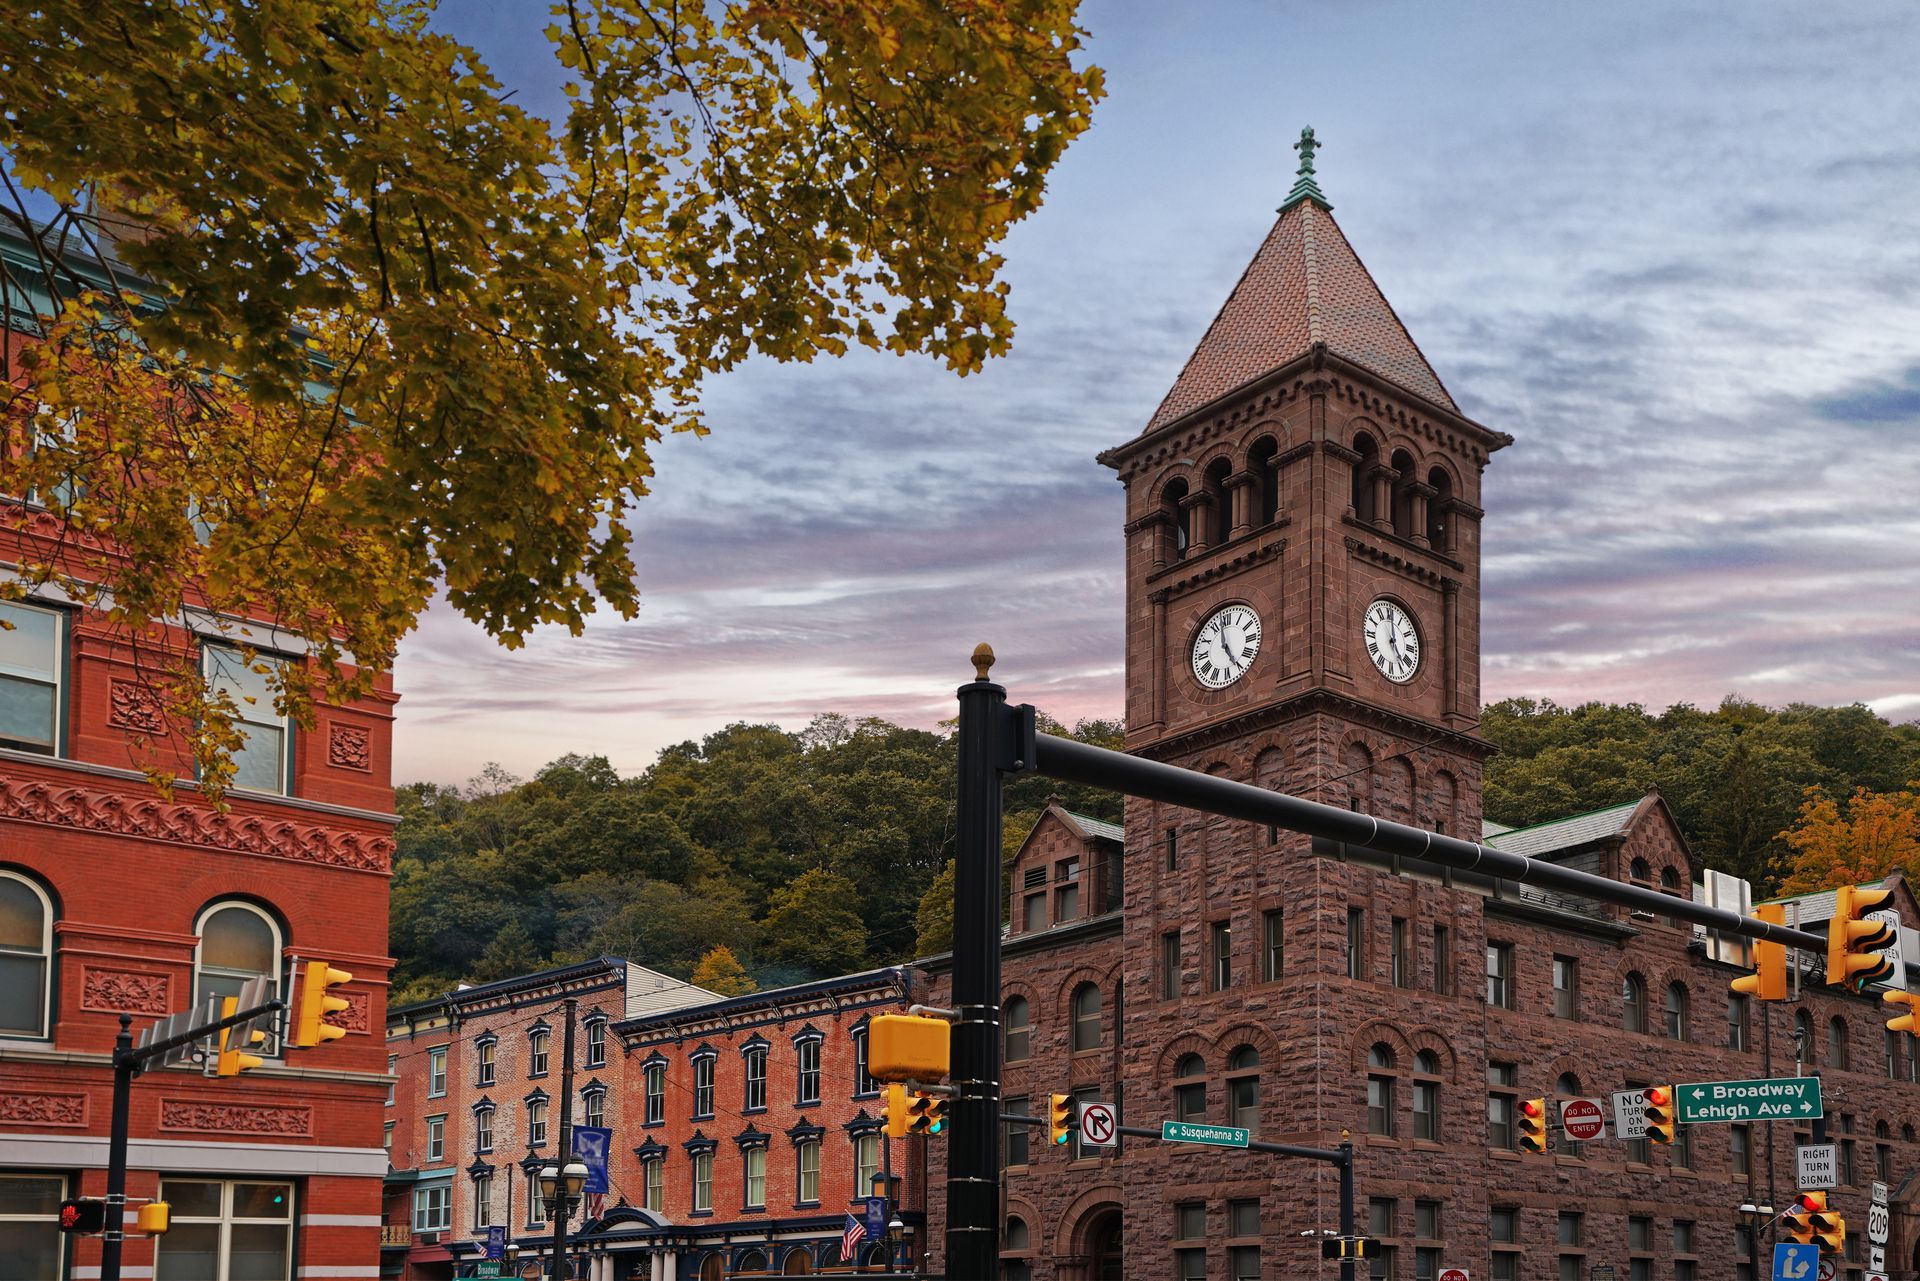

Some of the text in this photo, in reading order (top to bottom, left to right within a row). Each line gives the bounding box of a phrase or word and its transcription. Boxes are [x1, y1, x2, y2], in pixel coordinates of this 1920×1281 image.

[1713, 1083, 1805, 1099] Broadway
[1622, 1094, 1644, 1106] NO
[1567, 1106, 1596, 1116] DO NOT
[1622, 1106, 1647, 1116] TURN
[1687, 1102, 1792, 1120] Lehigh Ave
[1628, 1117, 1643, 1125] ON
[1181, 1126, 1244, 1141] Susquehanna St
[1572, 1125, 1596, 1133] ENTER
[1627, 1126, 1646, 1135] RED
[1803, 1149, 1830, 1159] RIGHT
[1805, 1162, 1829, 1171] TURN
[1801, 1175, 1834, 1184] SIGNAL
[1870, 1212, 1888, 1235] 209
[477, 1263, 499, 1276] Broadway
